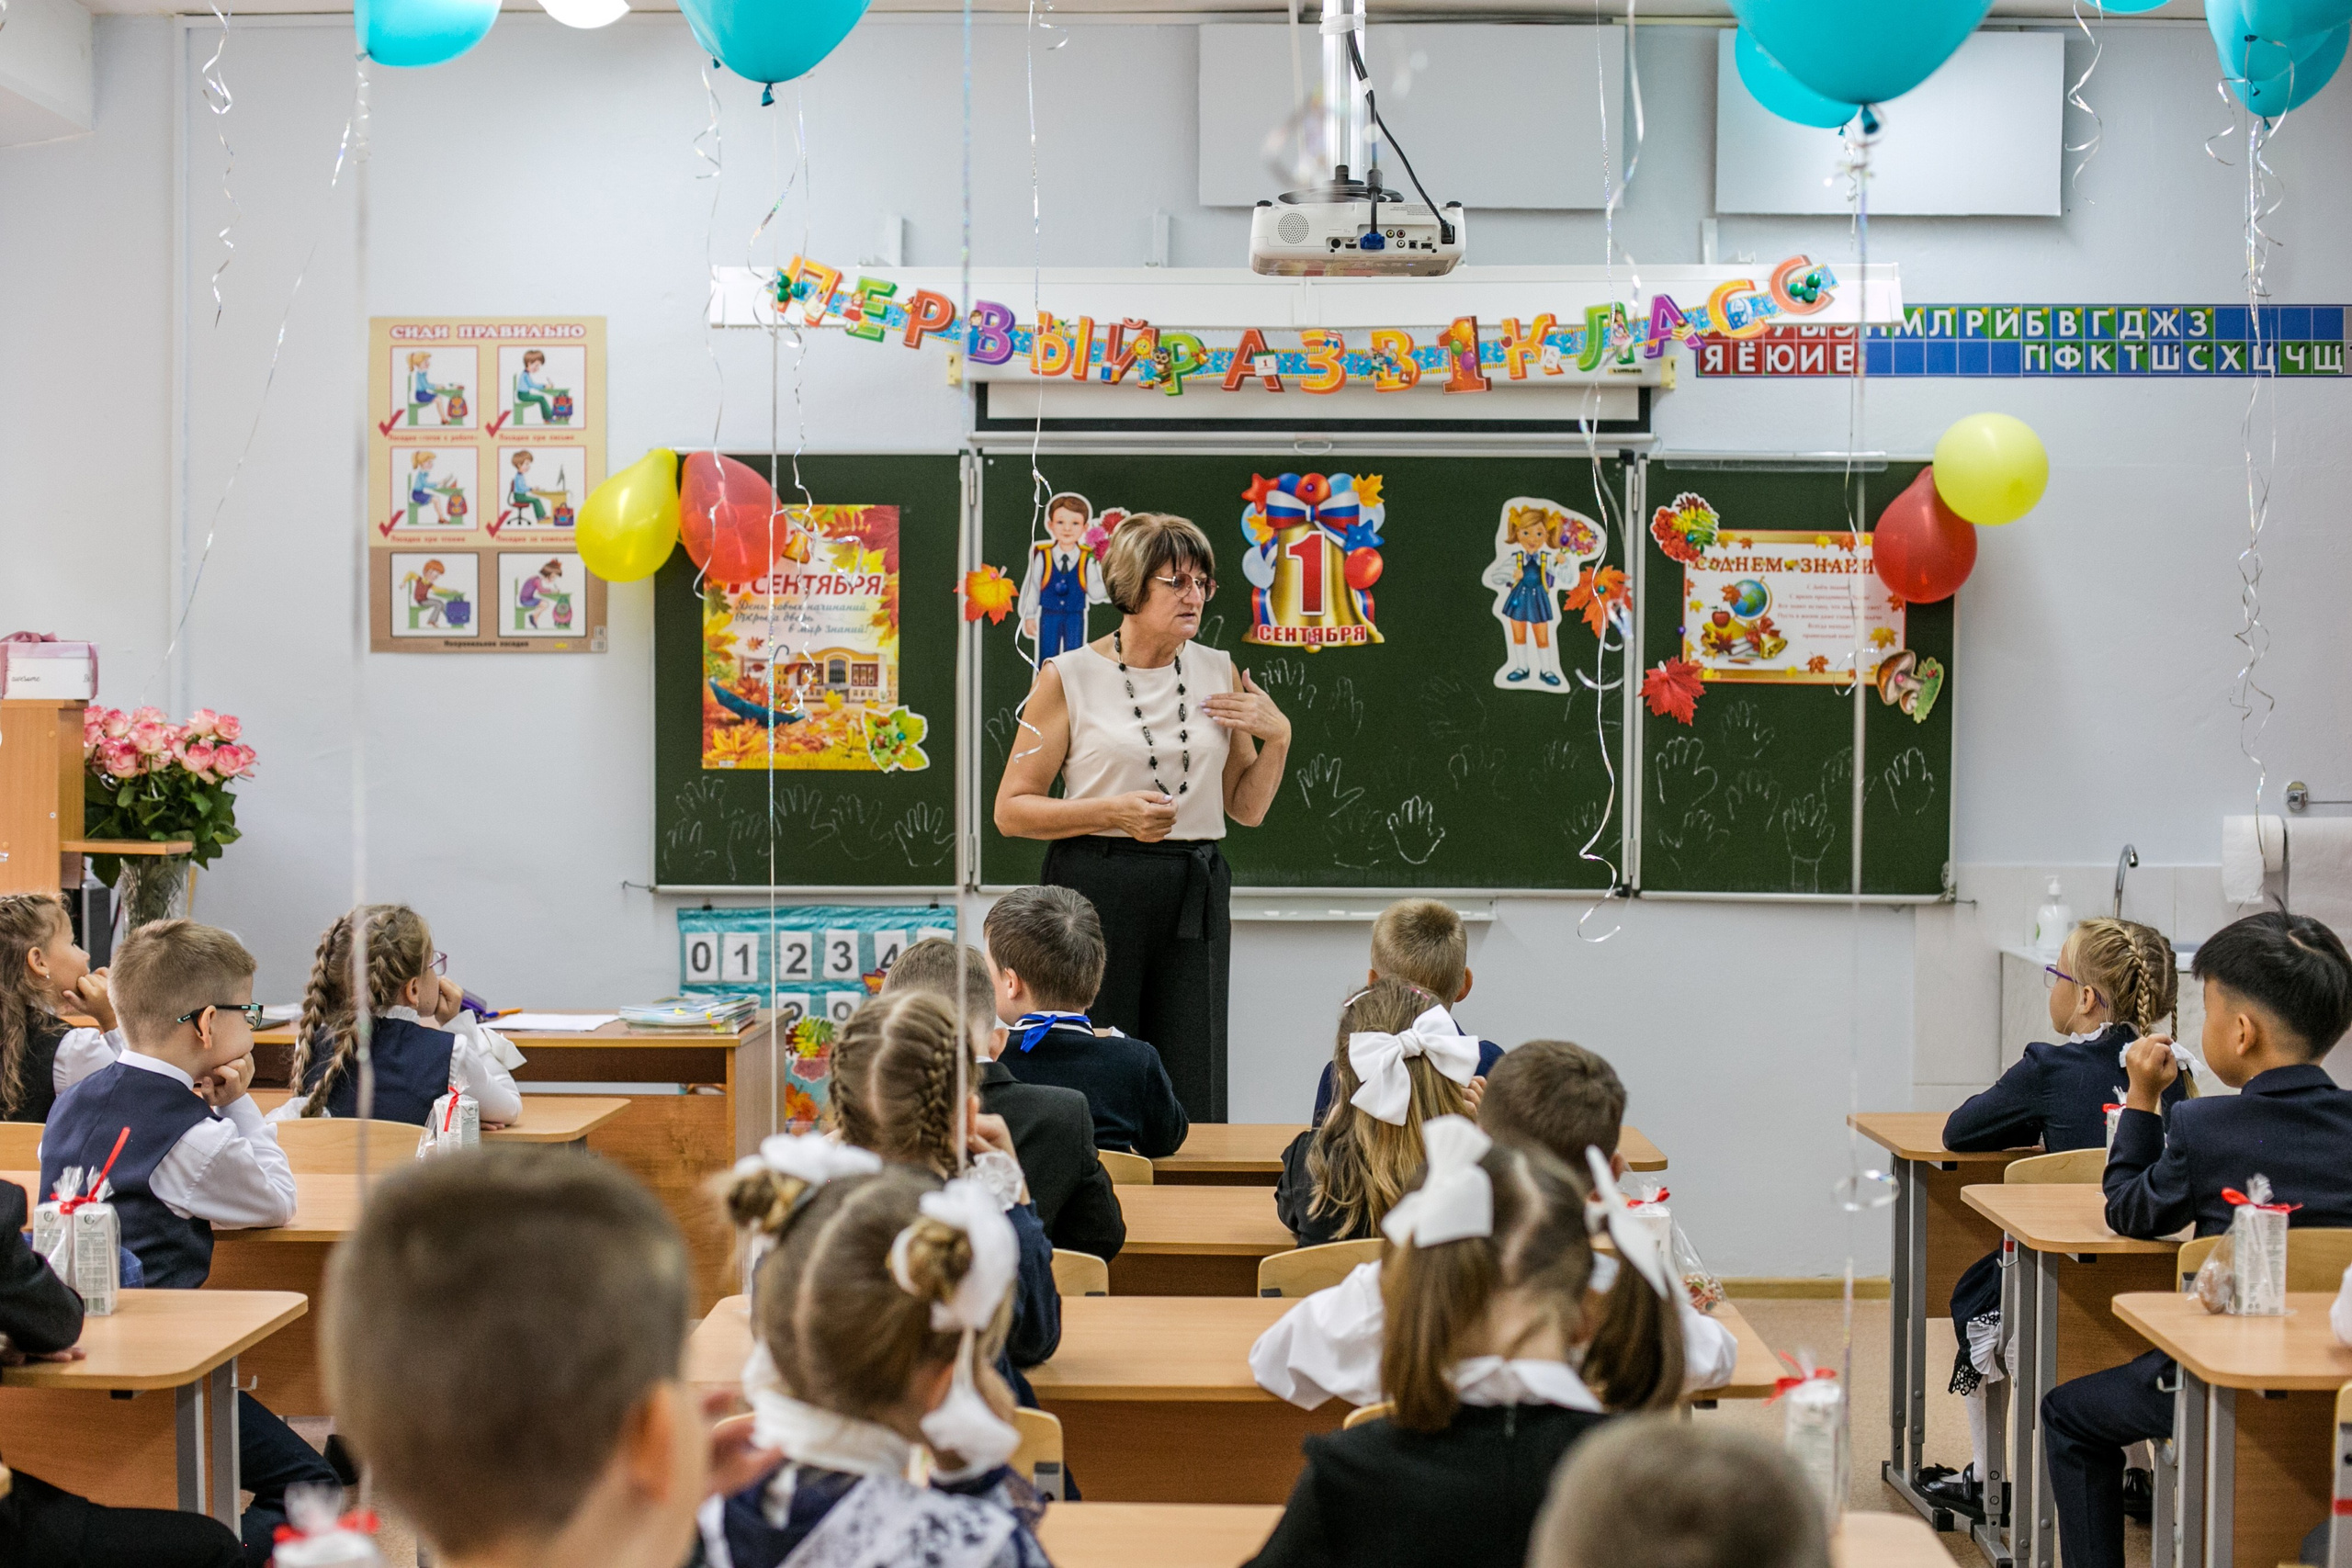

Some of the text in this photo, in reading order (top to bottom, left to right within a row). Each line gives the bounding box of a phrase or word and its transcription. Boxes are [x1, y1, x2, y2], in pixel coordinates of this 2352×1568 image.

[1500, 254, 1836, 380] КЛАСС
[390, 323, 587, 341] СИДИ ПРАВИЛЬНО
[1286, 530, 1326, 615] 1
[1800, 557, 1875, 575] ЗНАНИ
[751, 573, 882, 595] СЕНТЯБРЯ
[1257, 624, 1367, 643] СЕНТЯБРЯ
[692, 942, 712, 973] 0
[734, 943, 750, 976] 1
[786, 942, 808, 974] 2
[831, 940, 854, 972] 3
